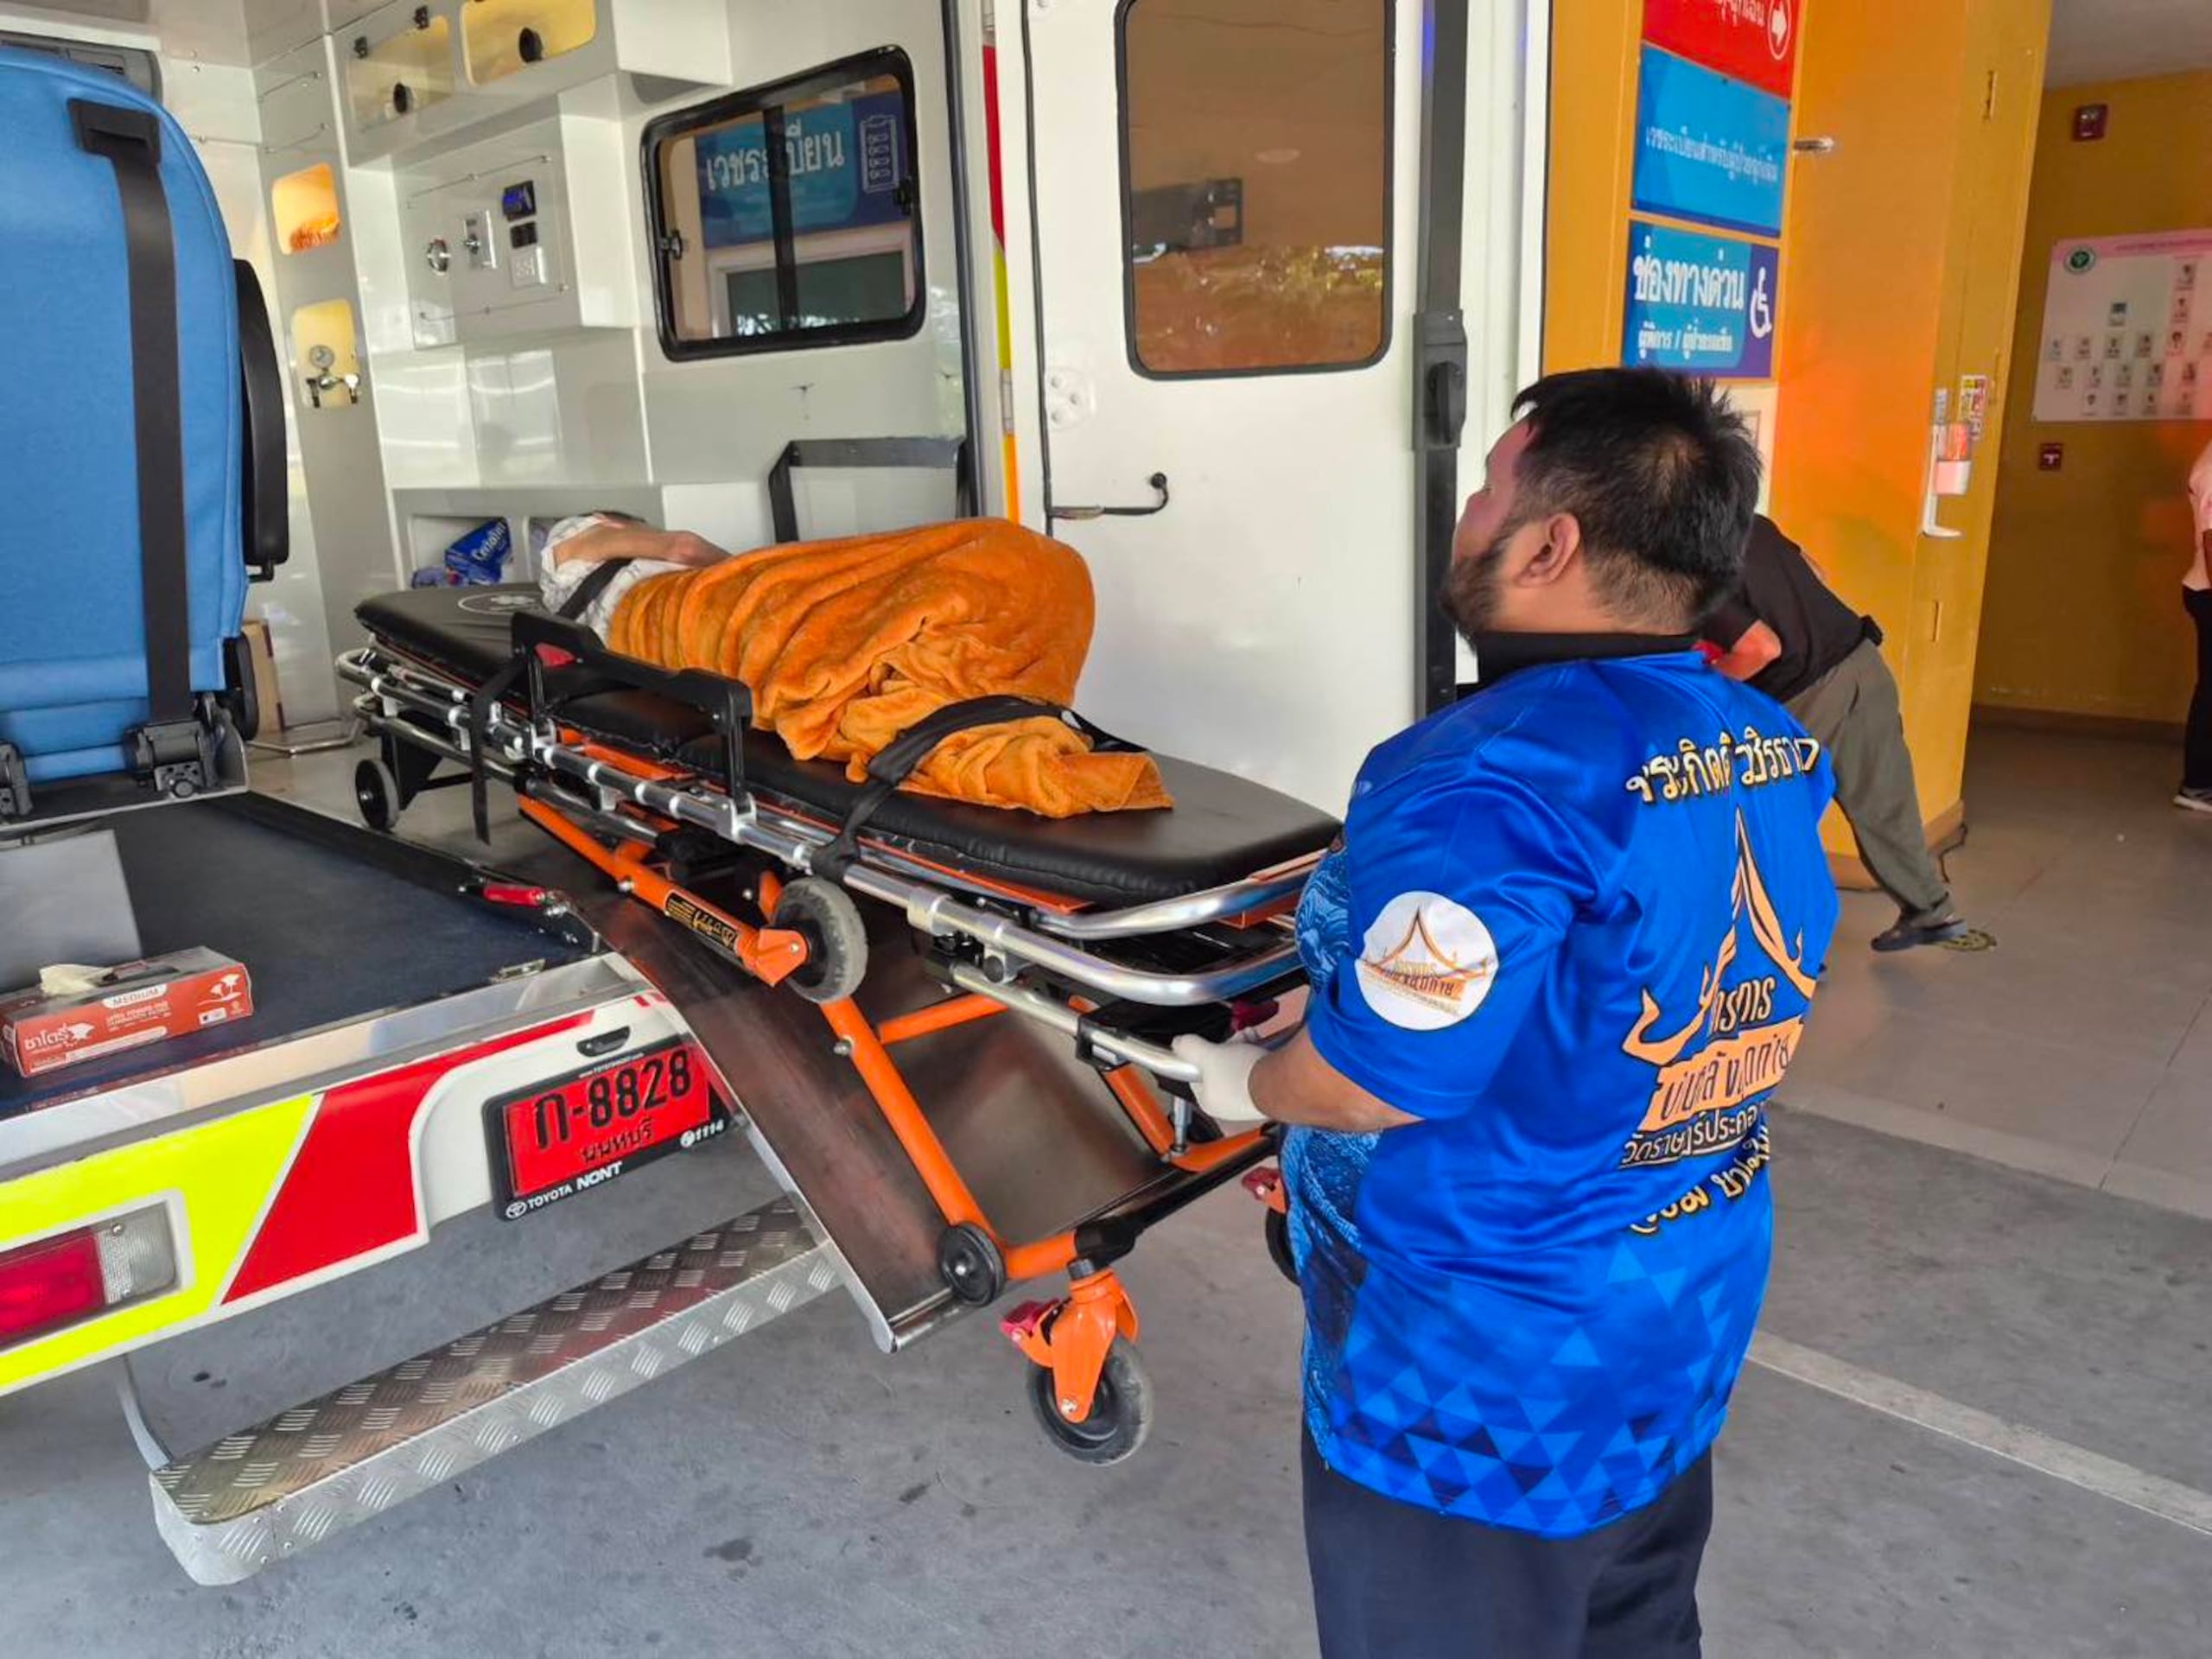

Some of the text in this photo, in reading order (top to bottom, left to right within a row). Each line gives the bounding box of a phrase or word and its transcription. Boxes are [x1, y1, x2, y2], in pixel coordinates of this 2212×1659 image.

[1632, 234, 1745, 310] ช่องทางด่วน
[527, 1160, 623, 1211] TOYOTA NONT
